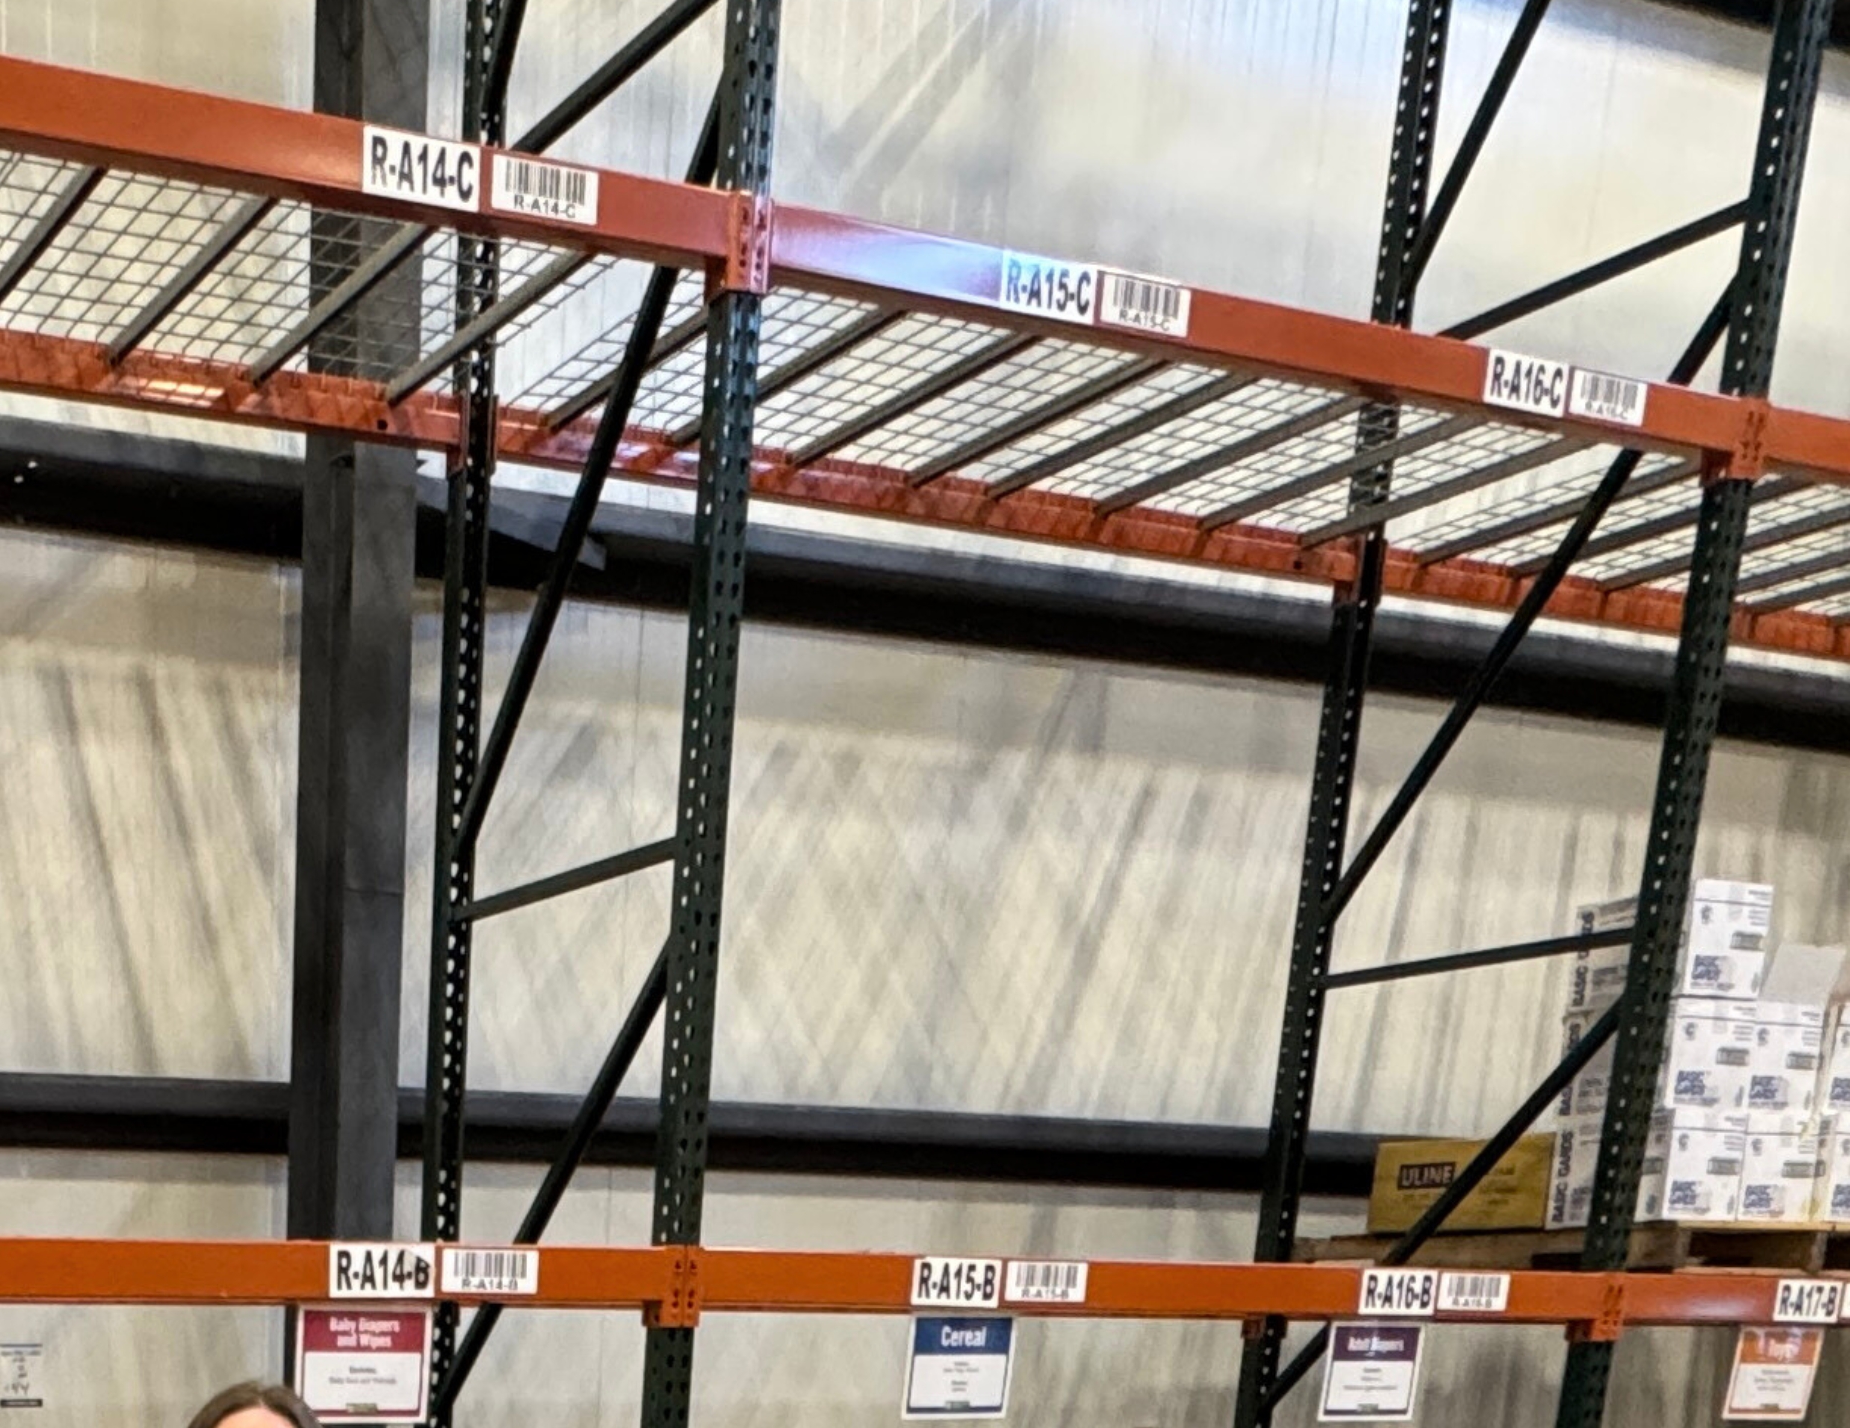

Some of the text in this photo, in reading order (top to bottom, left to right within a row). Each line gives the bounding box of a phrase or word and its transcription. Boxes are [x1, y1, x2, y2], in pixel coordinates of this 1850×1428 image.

[370, 135, 474, 203] R-A14-C
[514, 193, 577, 219] R-A14-C
[1006, 258, 1092, 315] R-A15-C
[1490, 355, 1564, 409] R-A16-C
[1401, 1165, 1453, 1187] ULINE
[336, 1250, 432, 1291] R-A14-B
[918, 1262, 997, 1301] R-A15-B
[1365, 1274, 1434, 1309] R-A16-B
[1778, 1284, 1838, 1317] R-A17-B
[941, 1326, 987, 1347] Cereal
